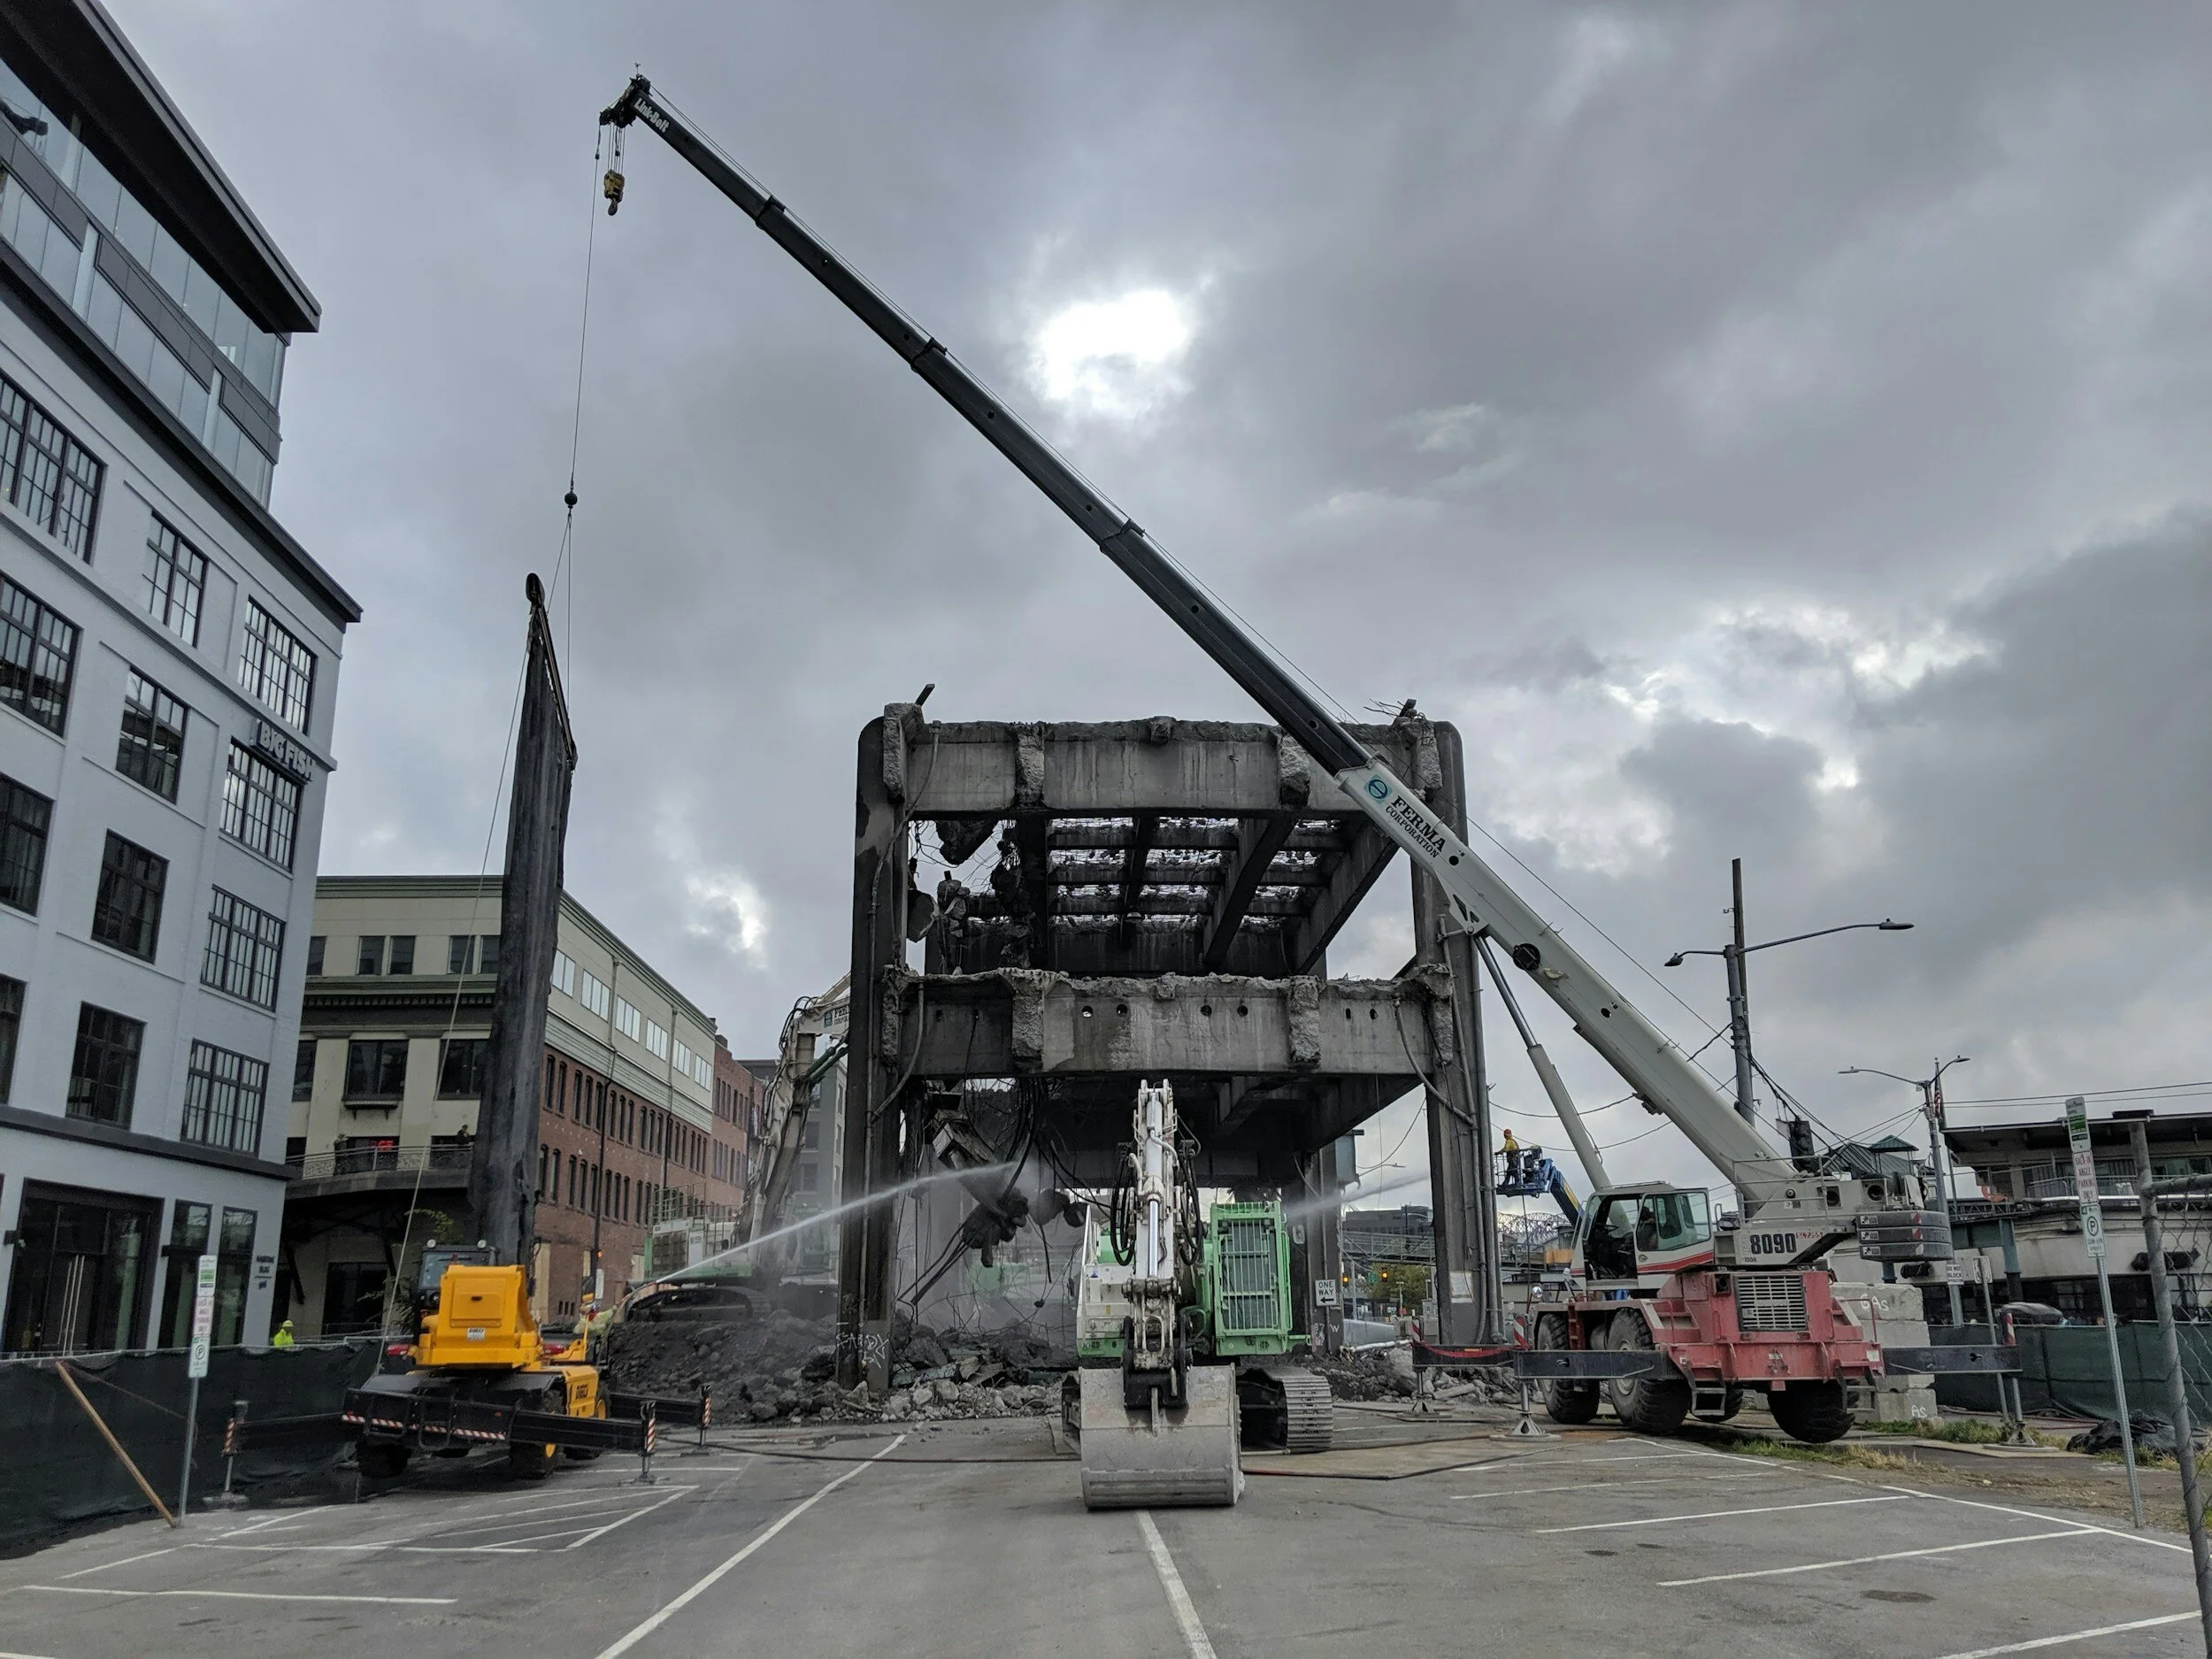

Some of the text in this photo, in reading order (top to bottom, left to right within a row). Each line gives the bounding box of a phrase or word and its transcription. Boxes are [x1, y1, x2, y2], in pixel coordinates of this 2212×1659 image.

[634, 97, 671, 134] Link-Belt
[259, 721, 317, 780] BIG FISH
[1386, 805, 1440, 858] CORPORATION
[1391, 795, 1447, 852] FERMA
[1750, 1233, 1797, 1254] 8090
